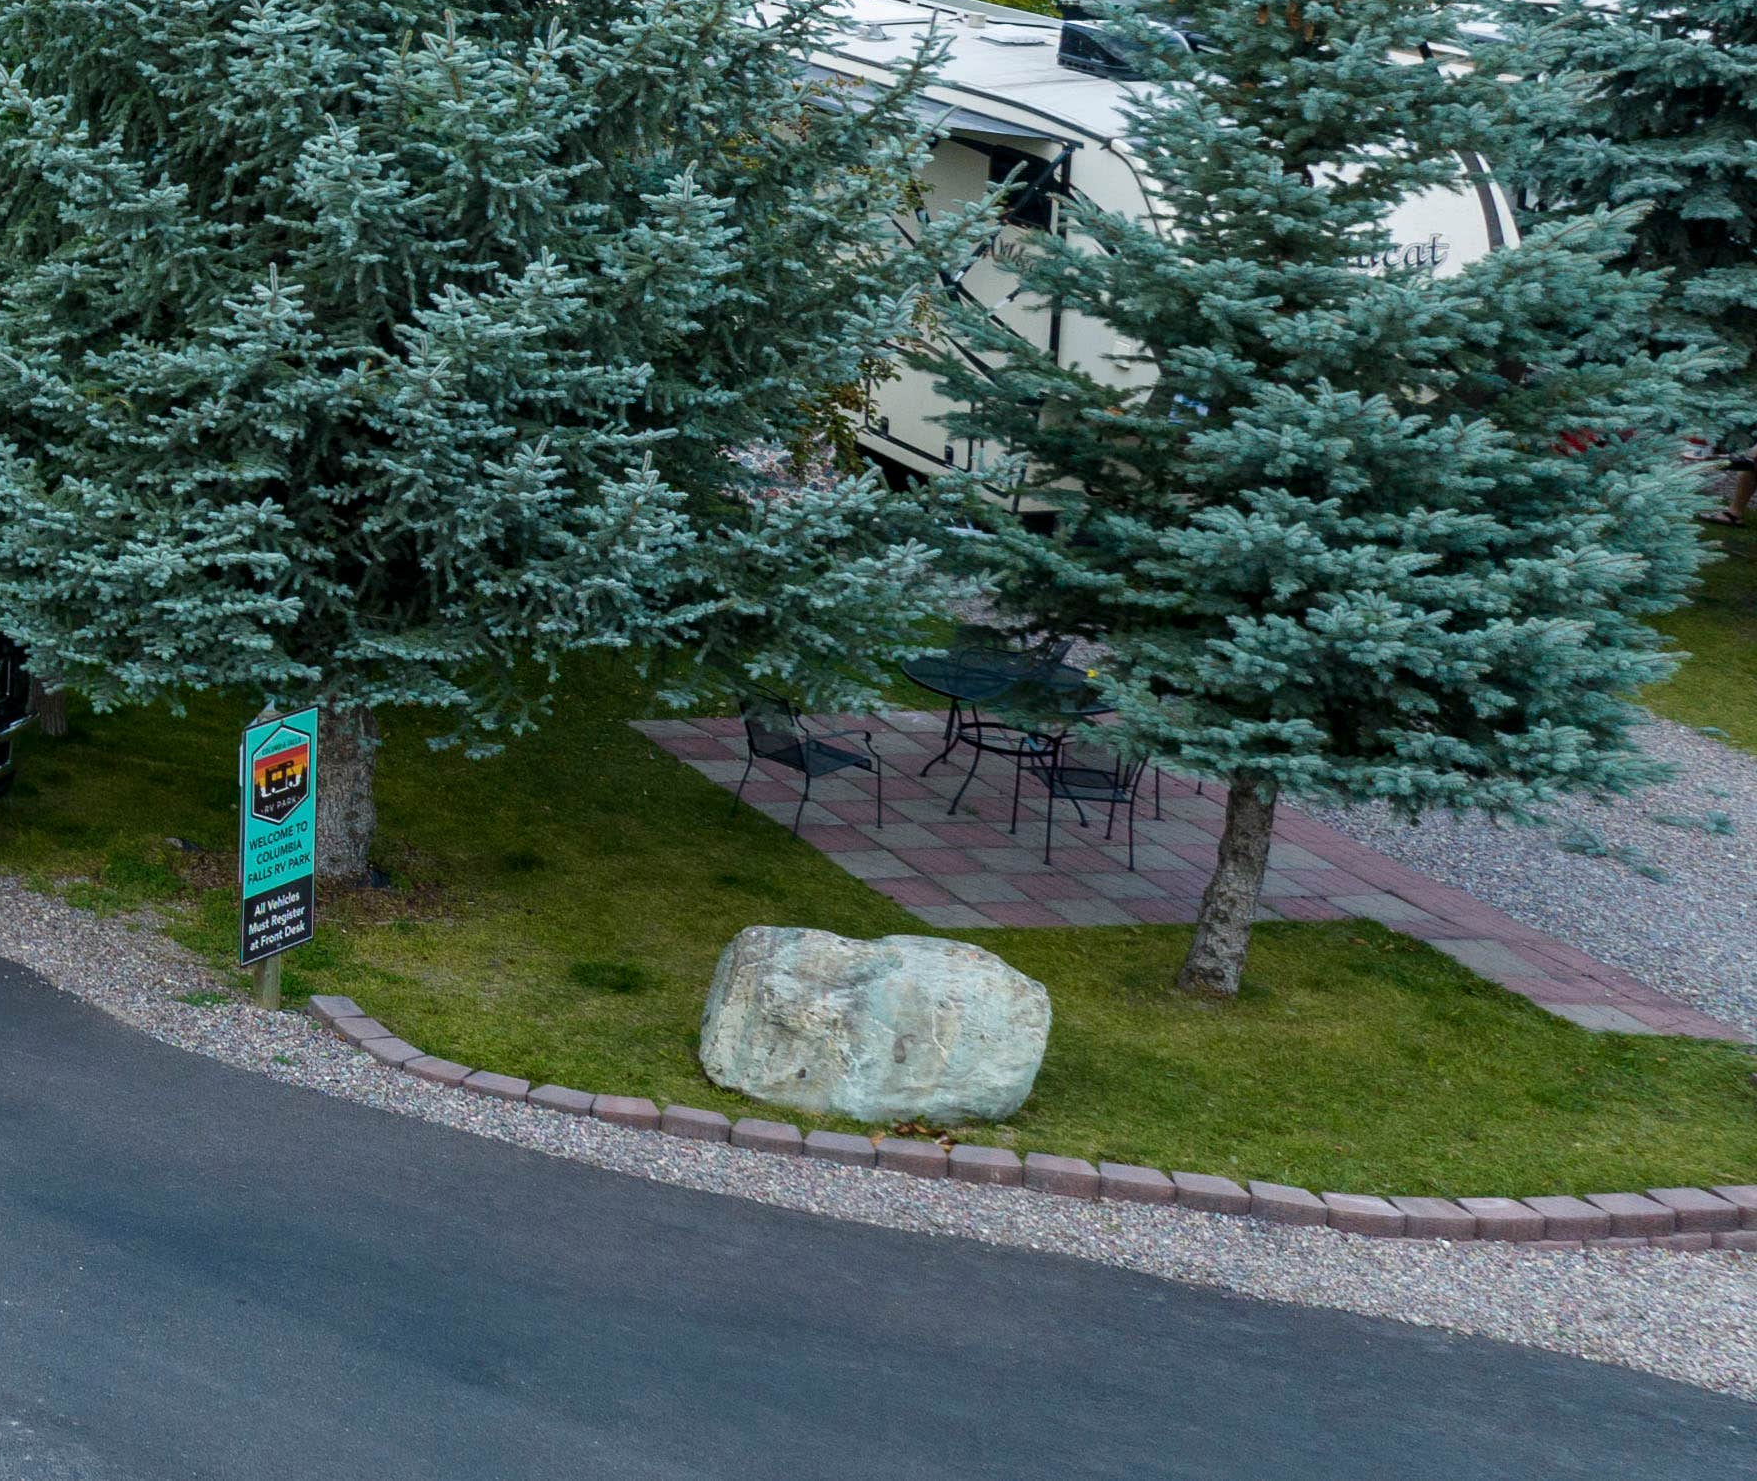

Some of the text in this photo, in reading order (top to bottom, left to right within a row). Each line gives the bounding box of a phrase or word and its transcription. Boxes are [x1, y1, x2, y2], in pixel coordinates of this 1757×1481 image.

[265, 797, 296, 813] RV PARK
[249, 821, 308, 851] WELCOME TO
[256, 839, 302, 865] COLUMBIA
[247, 852, 311, 885] FALLS RV PARK
[254, 891, 300, 917] All Vehicles
[248, 906, 305, 935] Must Register
[249, 920, 305, 951] at Front Desk
